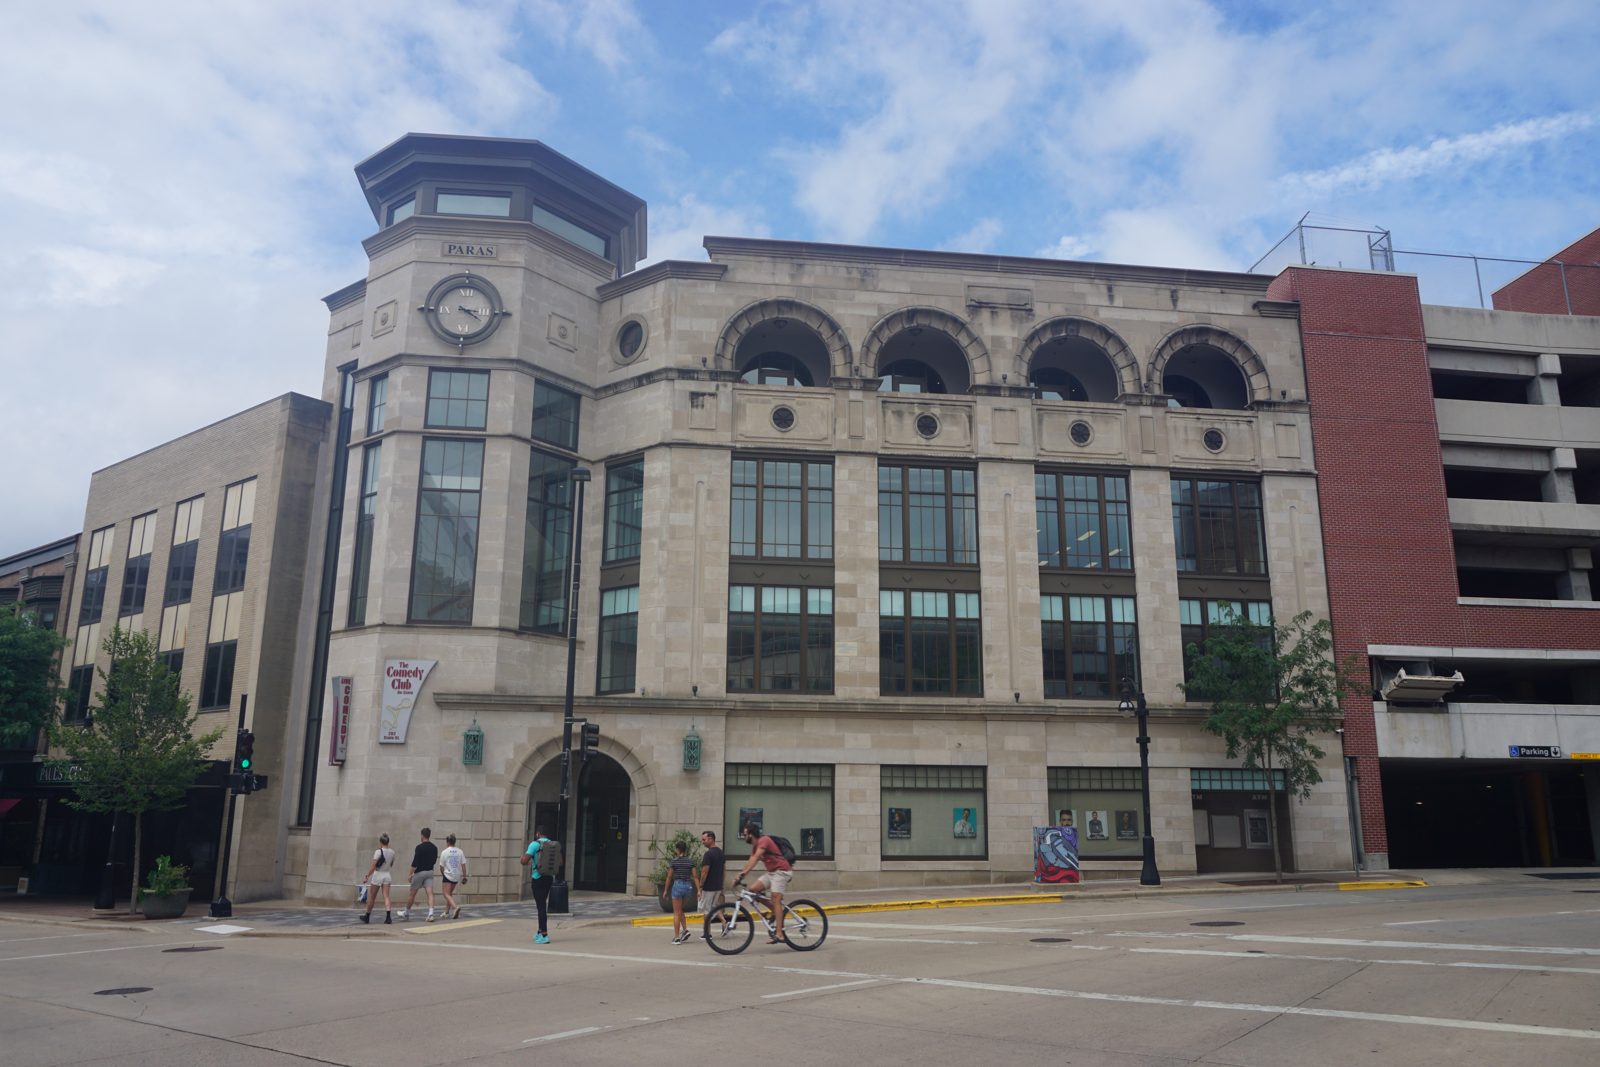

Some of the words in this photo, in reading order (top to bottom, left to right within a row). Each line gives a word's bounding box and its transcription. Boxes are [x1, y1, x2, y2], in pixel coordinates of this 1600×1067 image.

[448, 244, 493, 256] PARAS
[460, 289, 473, 297] XII
[440, 306, 450, 314] IX
[478, 308, 490, 316] III
[458, 324, 469, 333] VI
[386, 666, 424, 680] Comedy
[391, 679, 412, 690] Club
[340, 685, 351, 745] COMEDY
[1521, 747, 1549, 757] Parking
